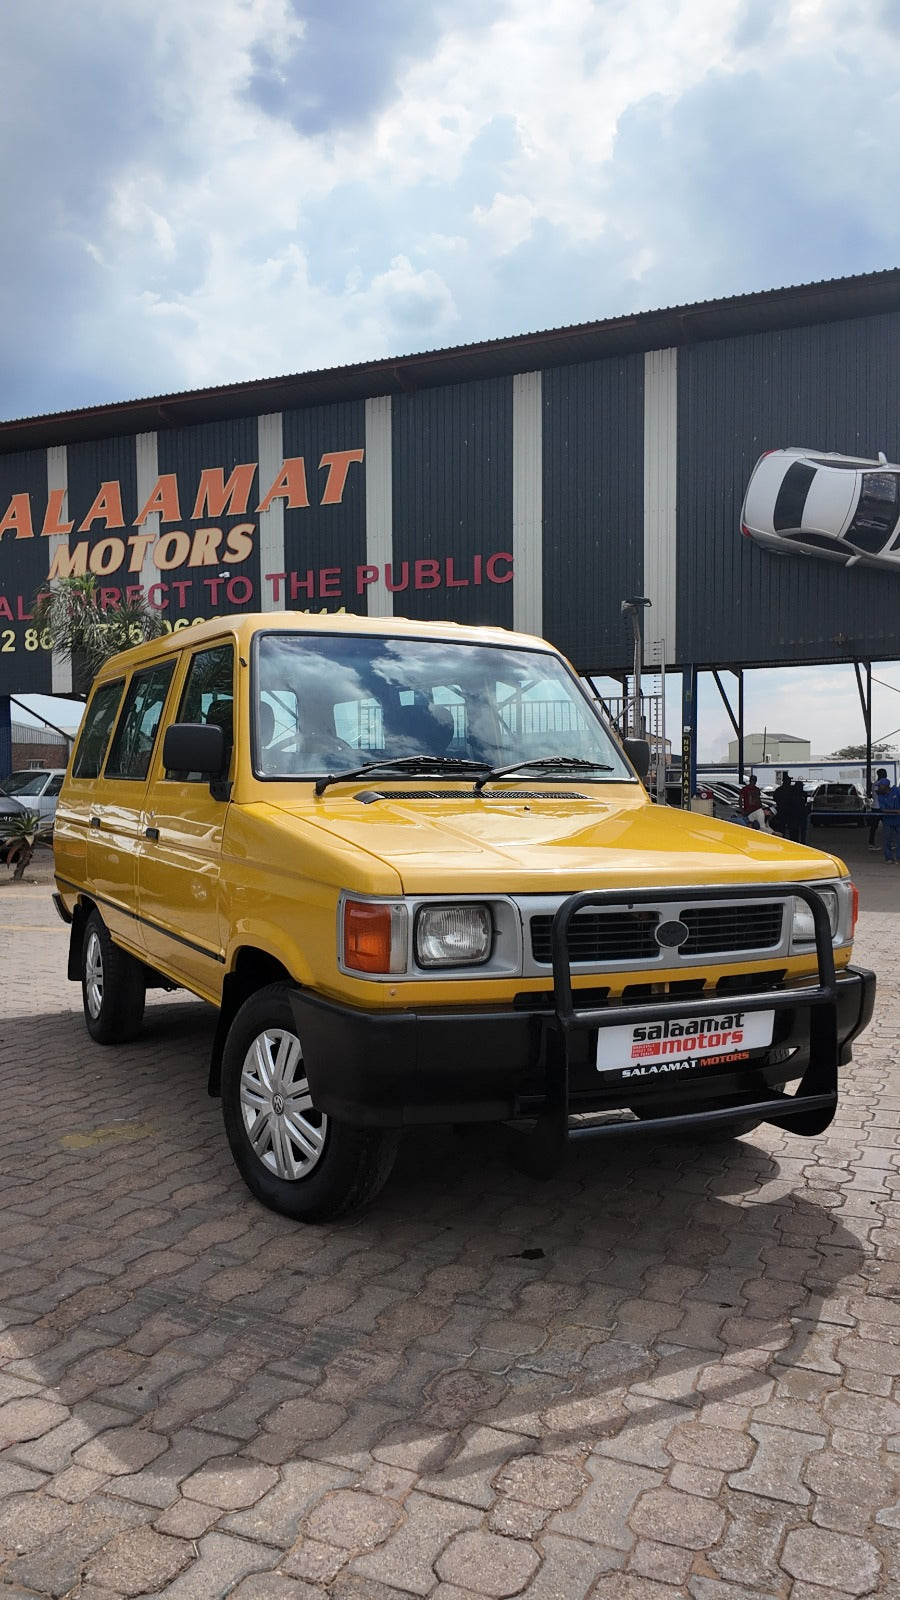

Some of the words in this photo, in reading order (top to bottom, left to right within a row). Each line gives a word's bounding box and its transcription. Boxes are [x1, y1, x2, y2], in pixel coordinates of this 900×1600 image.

[47, 523, 256, 580] MOTORS
[204, 575, 254, 606] TO
[265, 567, 342, 602] THE
[356, 552, 515, 595] PUBLIC
[632, 1013, 745, 1042] salaamat
[661, 1030, 744, 1054] motors
[621, 1059, 698, 1078] SALAAMAT
[700, 1051, 750, 1067] MOTORS
